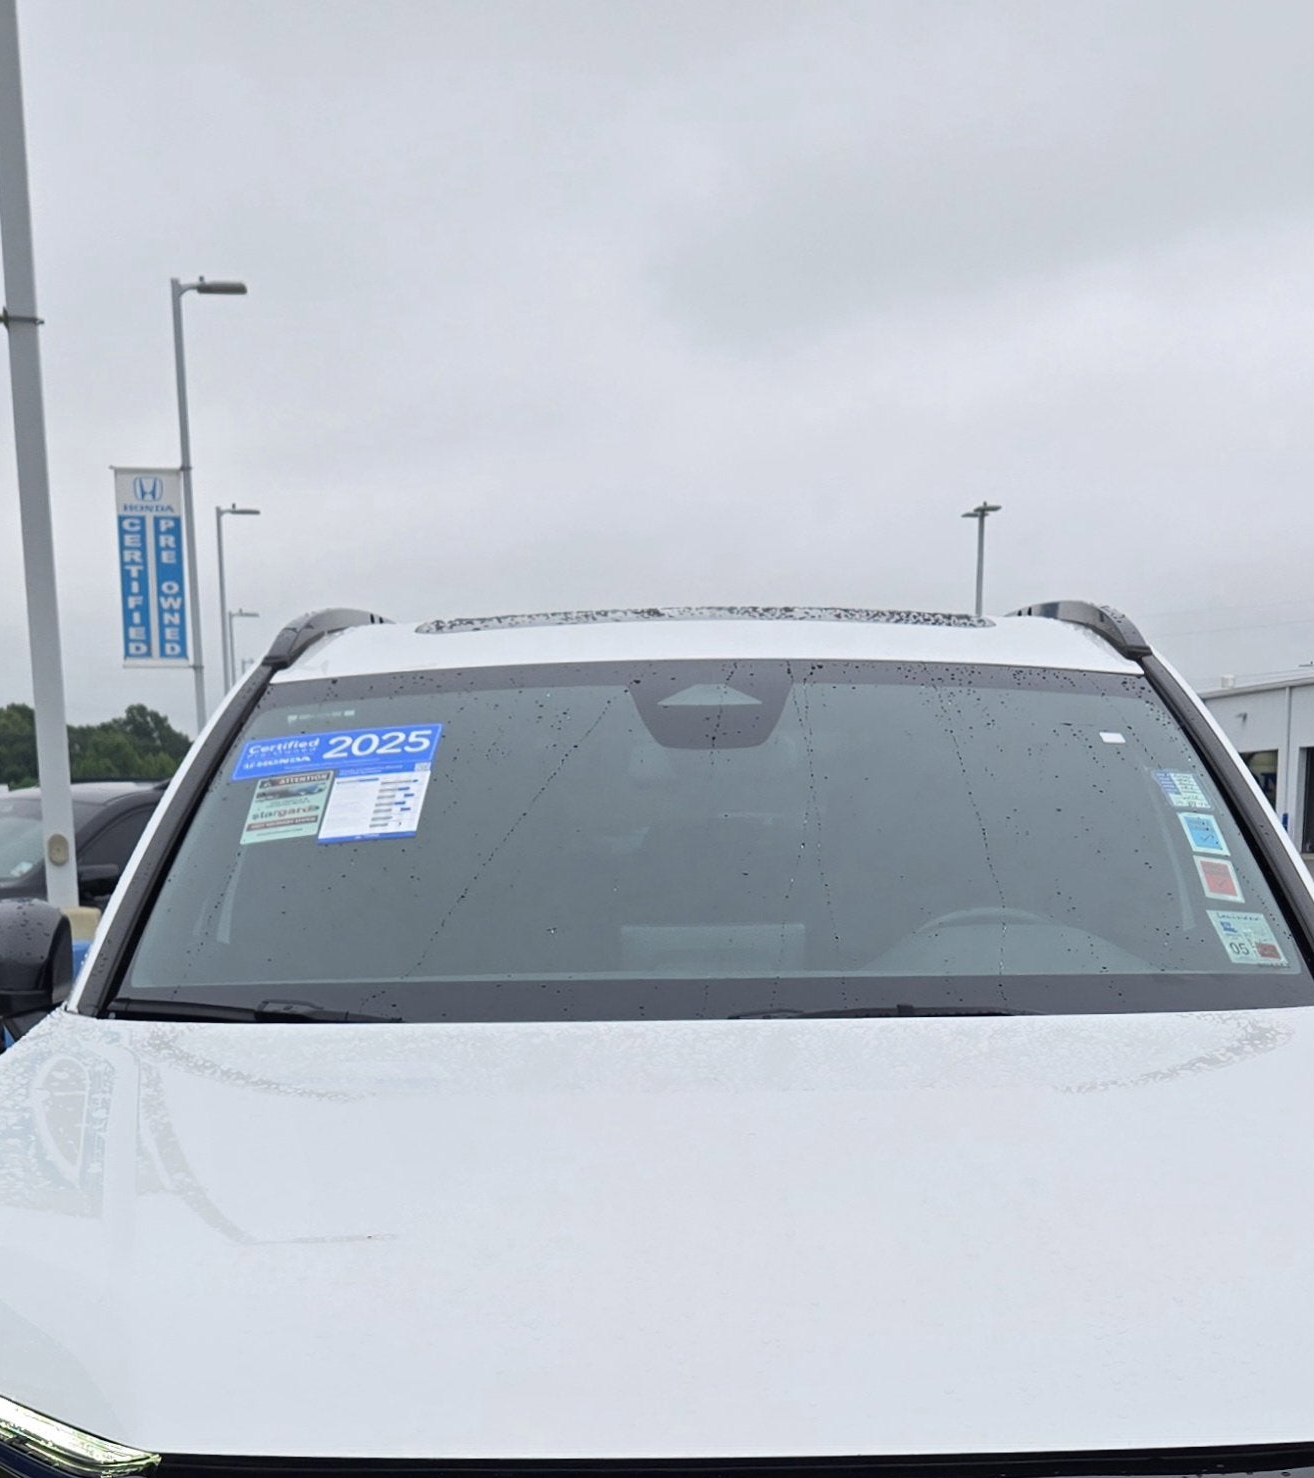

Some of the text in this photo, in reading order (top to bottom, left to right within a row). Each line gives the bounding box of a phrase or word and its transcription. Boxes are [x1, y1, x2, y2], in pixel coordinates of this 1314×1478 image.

[123, 503, 174, 513] HONDA
[121, 518, 148, 655] CERTIFIED
[158, 519, 182, 656] PRE OWNED
[248, 737, 320, 755] Certified
[322, 730, 432, 760] 2025
[1229, 942, 1250, 955] 05
